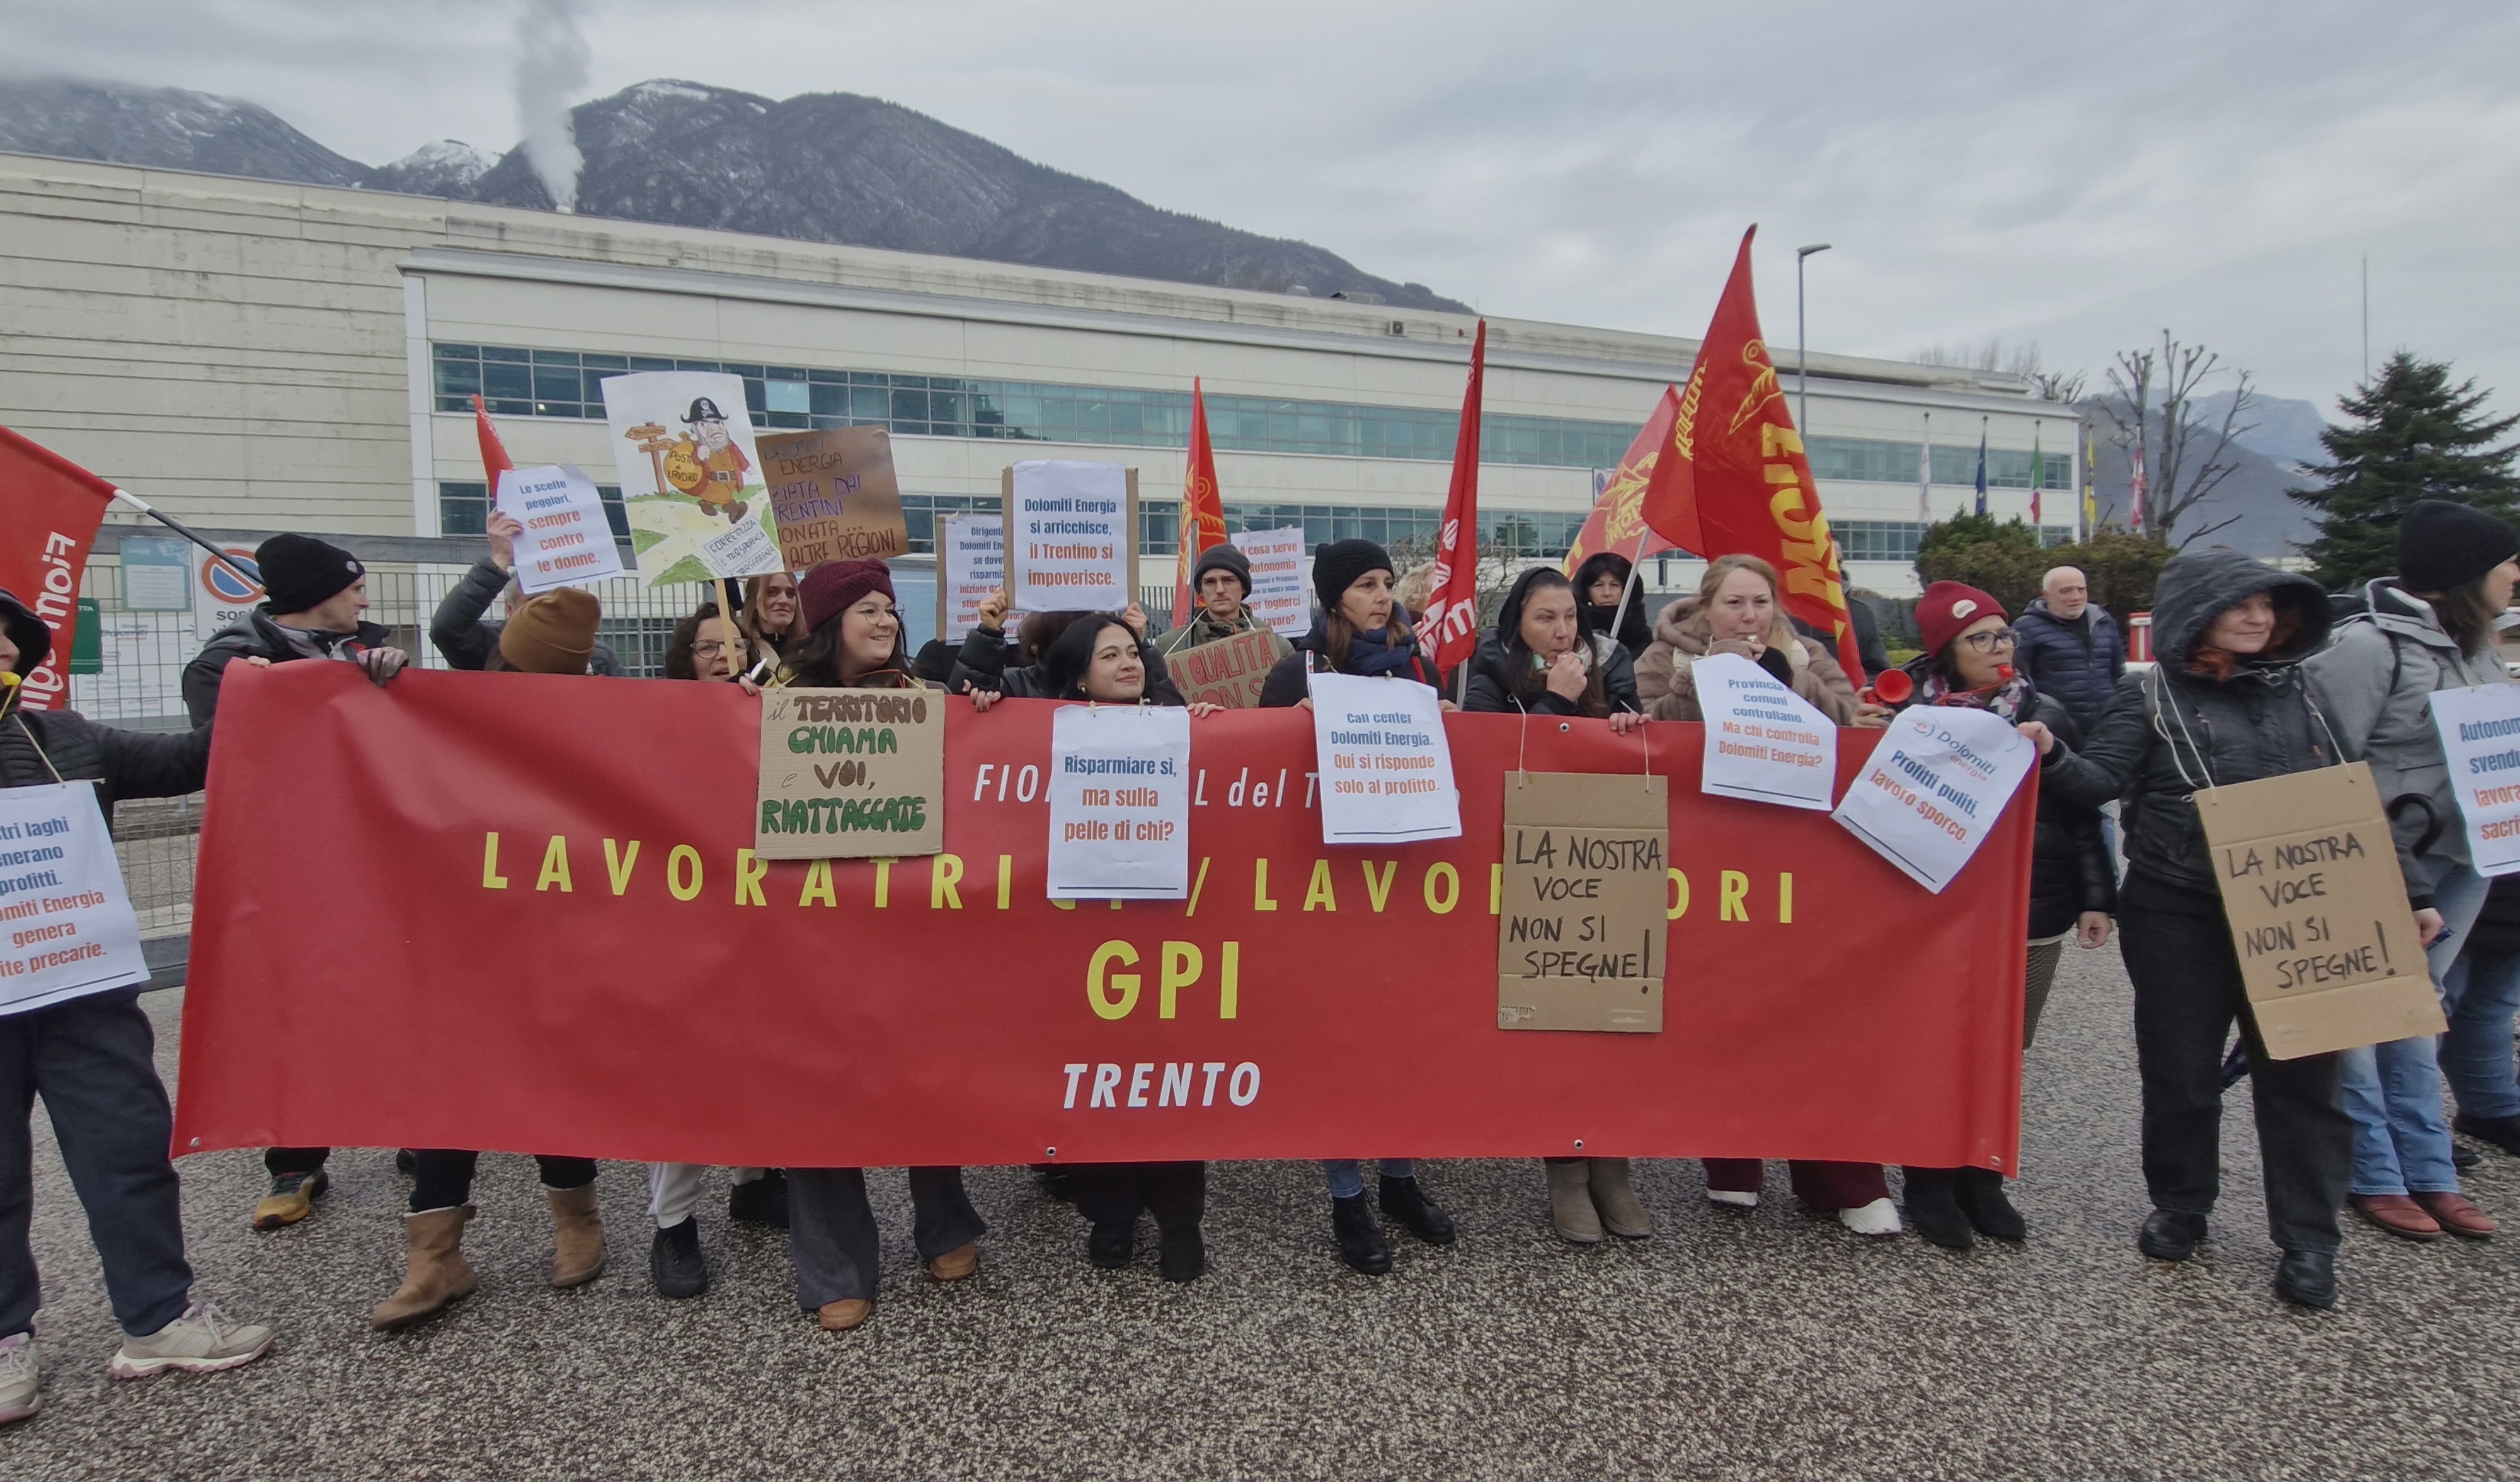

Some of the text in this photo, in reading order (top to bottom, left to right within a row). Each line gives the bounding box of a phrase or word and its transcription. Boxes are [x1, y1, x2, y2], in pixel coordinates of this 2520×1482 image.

[779, 452, 842, 476] ENERGIA
[519, 480, 566, 495] Le scelte
[833, 474, 861, 497] DAI
[1024, 498, 1116, 514] Dolomiti Energia
[527, 510, 581, 530] sempre
[1030, 519, 1111, 536] si arricchisce,
[539, 532, 585, 551] contro
[778, 520, 839, 546] ONATA
[837, 528, 897, 560] REGIONI
[960, 541, 991, 551] Dolomiti
[1029, 543, 1113, 560] il Trentino si
[1248, 546, 1270, 556] cosa
[1273, 543, 1298, 553] serve
[537, 552, 601, 573] le donne.
[973, 556, 1004, 565] se dove
[959, 585, 987, 594] iniziate
[1028, 569, 1115, 588] impoverisce.
[1264, 595, 1301, 610] toglierci
[1264, 614, 1296, 627] lavoro?
[1728, 679, 1784, 691] Provincia
[767, 694, 927, 724] il TERRITORIO
[1743, 694, 1788, 706] comuni
[1347, 713, 1412, 724] Call center
[788, 725, 897, 755] CHIAMA
[1331, 731, 1434, 747] Dolomiti Energia.
[1723, 721, 1819, 745] Ma chi controlla
[1334, 753, 1435, 771] Qui si risponde
[1719, 740, 1822, 768] Dolomiti Energia?
[1936, 730, 1998, 775] Dolomiti
[1065, 755, 1177, 778] Risparmiare sì,
[1949, 754, 1988, 783] energia
[1228, 767, 1286, 808] del
[1335, 778, 1440, 796] solo al profitto.
[1890, 749, 1979, 820] Profitti puliti,
[1082, 787, 1159, 807] ma sulla
[1869, 767, 1967, 844] lavoro sporco.
[25, 816, 70, 837] laghi
[760, 795, 927, 835] RIATTACCATE
[1065, 819, 1174, 842] pelle di chi?
[1516, 830, 1662, 872] LA NOSTRA
[2226, 832, 2365, 879] LA NOSTRA
[1533, 876, 1602, 901] VOCE
[2259, 872, 2327, 909] VOCE
[42, 890, 105, 913] Energia
[12, 922, 76, 949] genera
[1509, 914, 1606, 943] NON SI
[2245, 916, 2330, 958] NON SI
[29, 942, 107, 973] precarie.
[1086, 939, 1239, 1020] GPI
[1063, 1061, 1260, 1109] TRENTO
